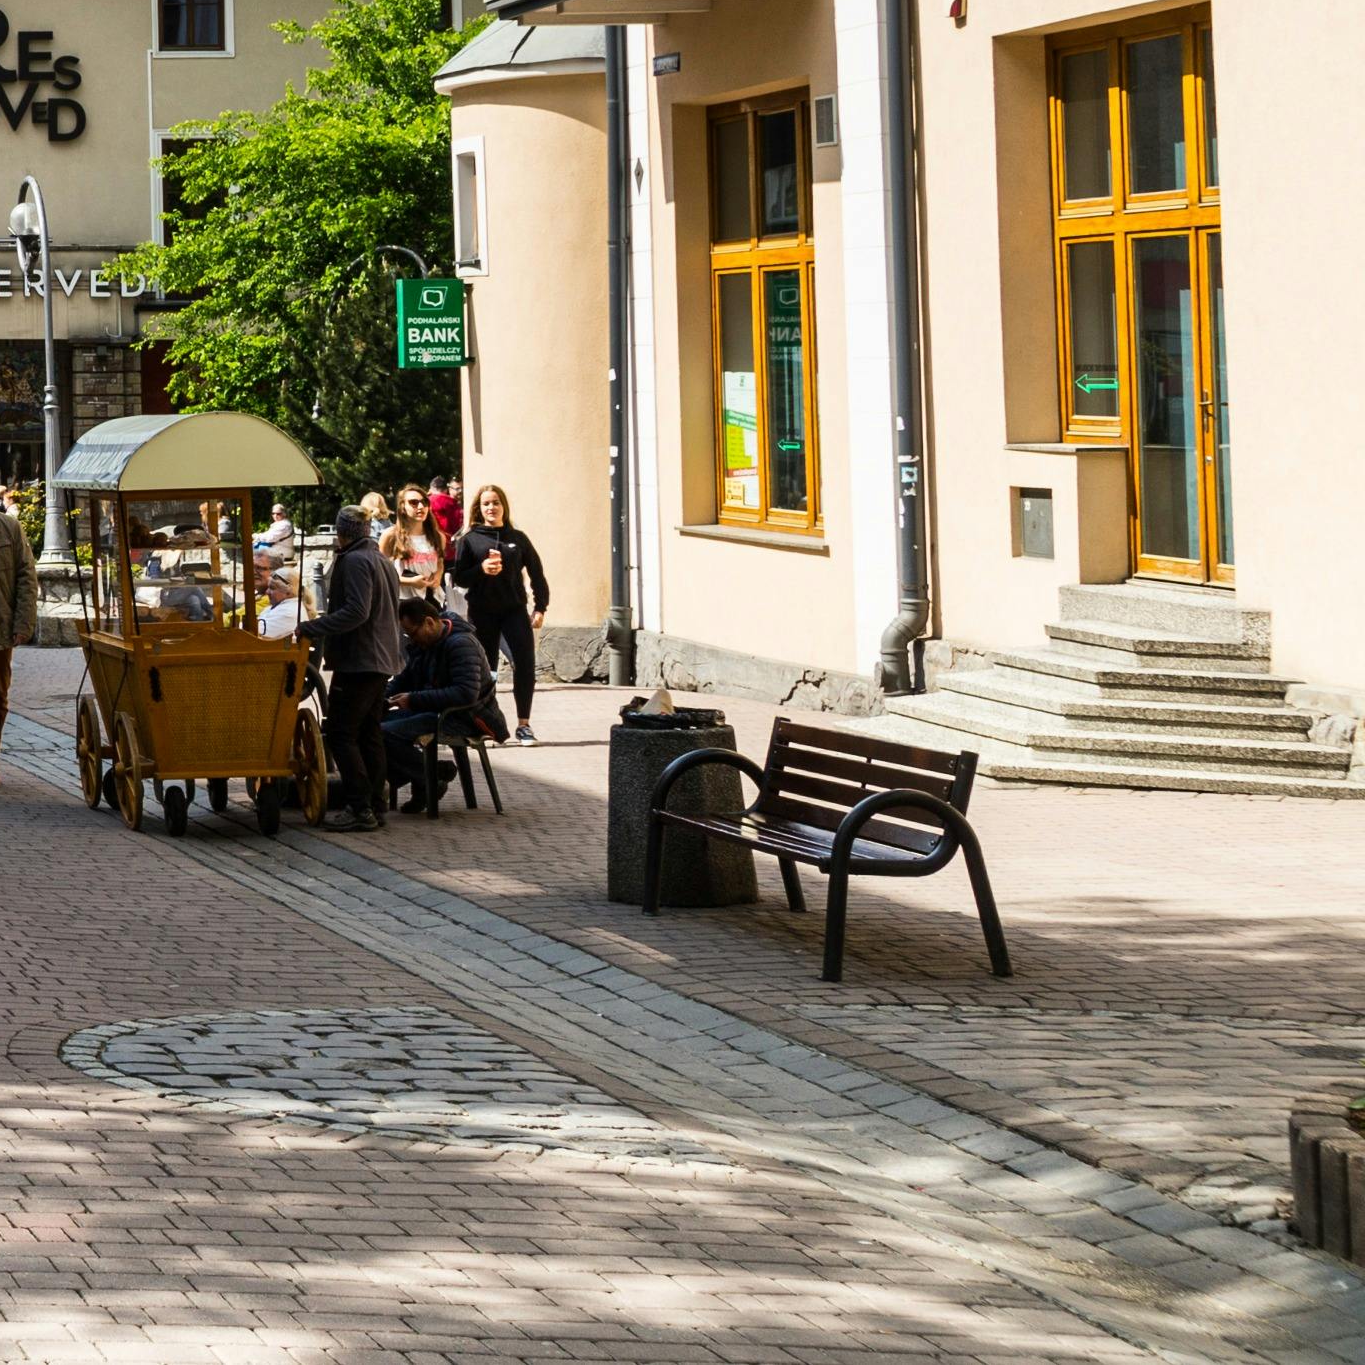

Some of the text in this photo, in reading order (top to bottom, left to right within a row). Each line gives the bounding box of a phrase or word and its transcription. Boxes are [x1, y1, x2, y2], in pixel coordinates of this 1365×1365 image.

[407, 316, 461, 325] PODHALAŃSKI
[408, 327, 461, 343] BANK
[409, 355, 417, 363] W
